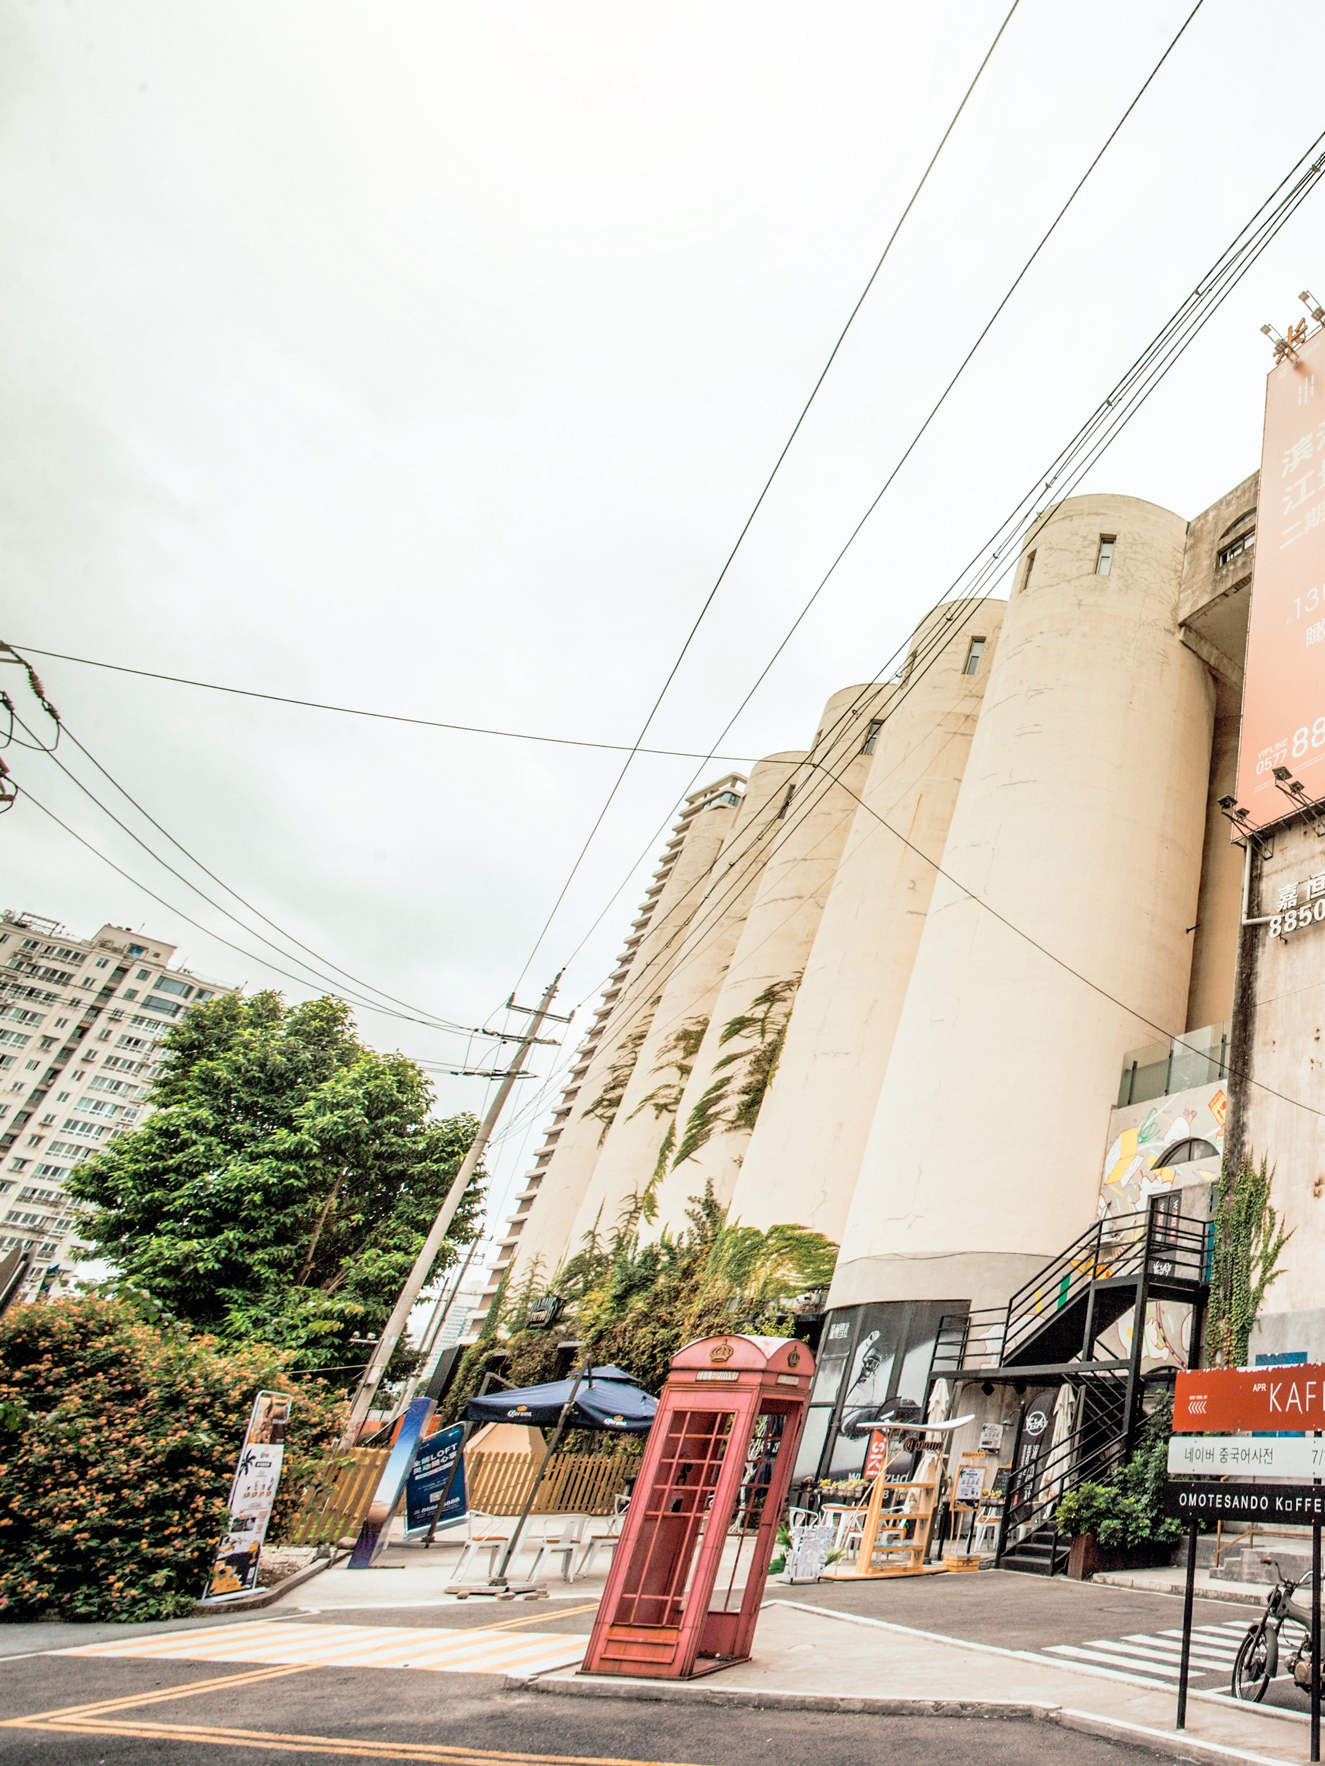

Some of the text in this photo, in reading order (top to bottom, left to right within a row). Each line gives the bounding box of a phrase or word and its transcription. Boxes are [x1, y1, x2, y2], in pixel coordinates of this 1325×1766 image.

[1256, 748, 1288, 775] 0577
[1252, 1383, 1267, 1392] APR
[1184, 1447, 1214, 1463] 네이버
[1219, 1447, 1273, 1465] 중국어사전
[1179, 1493, 1269, 1510] OMOTESANDO
